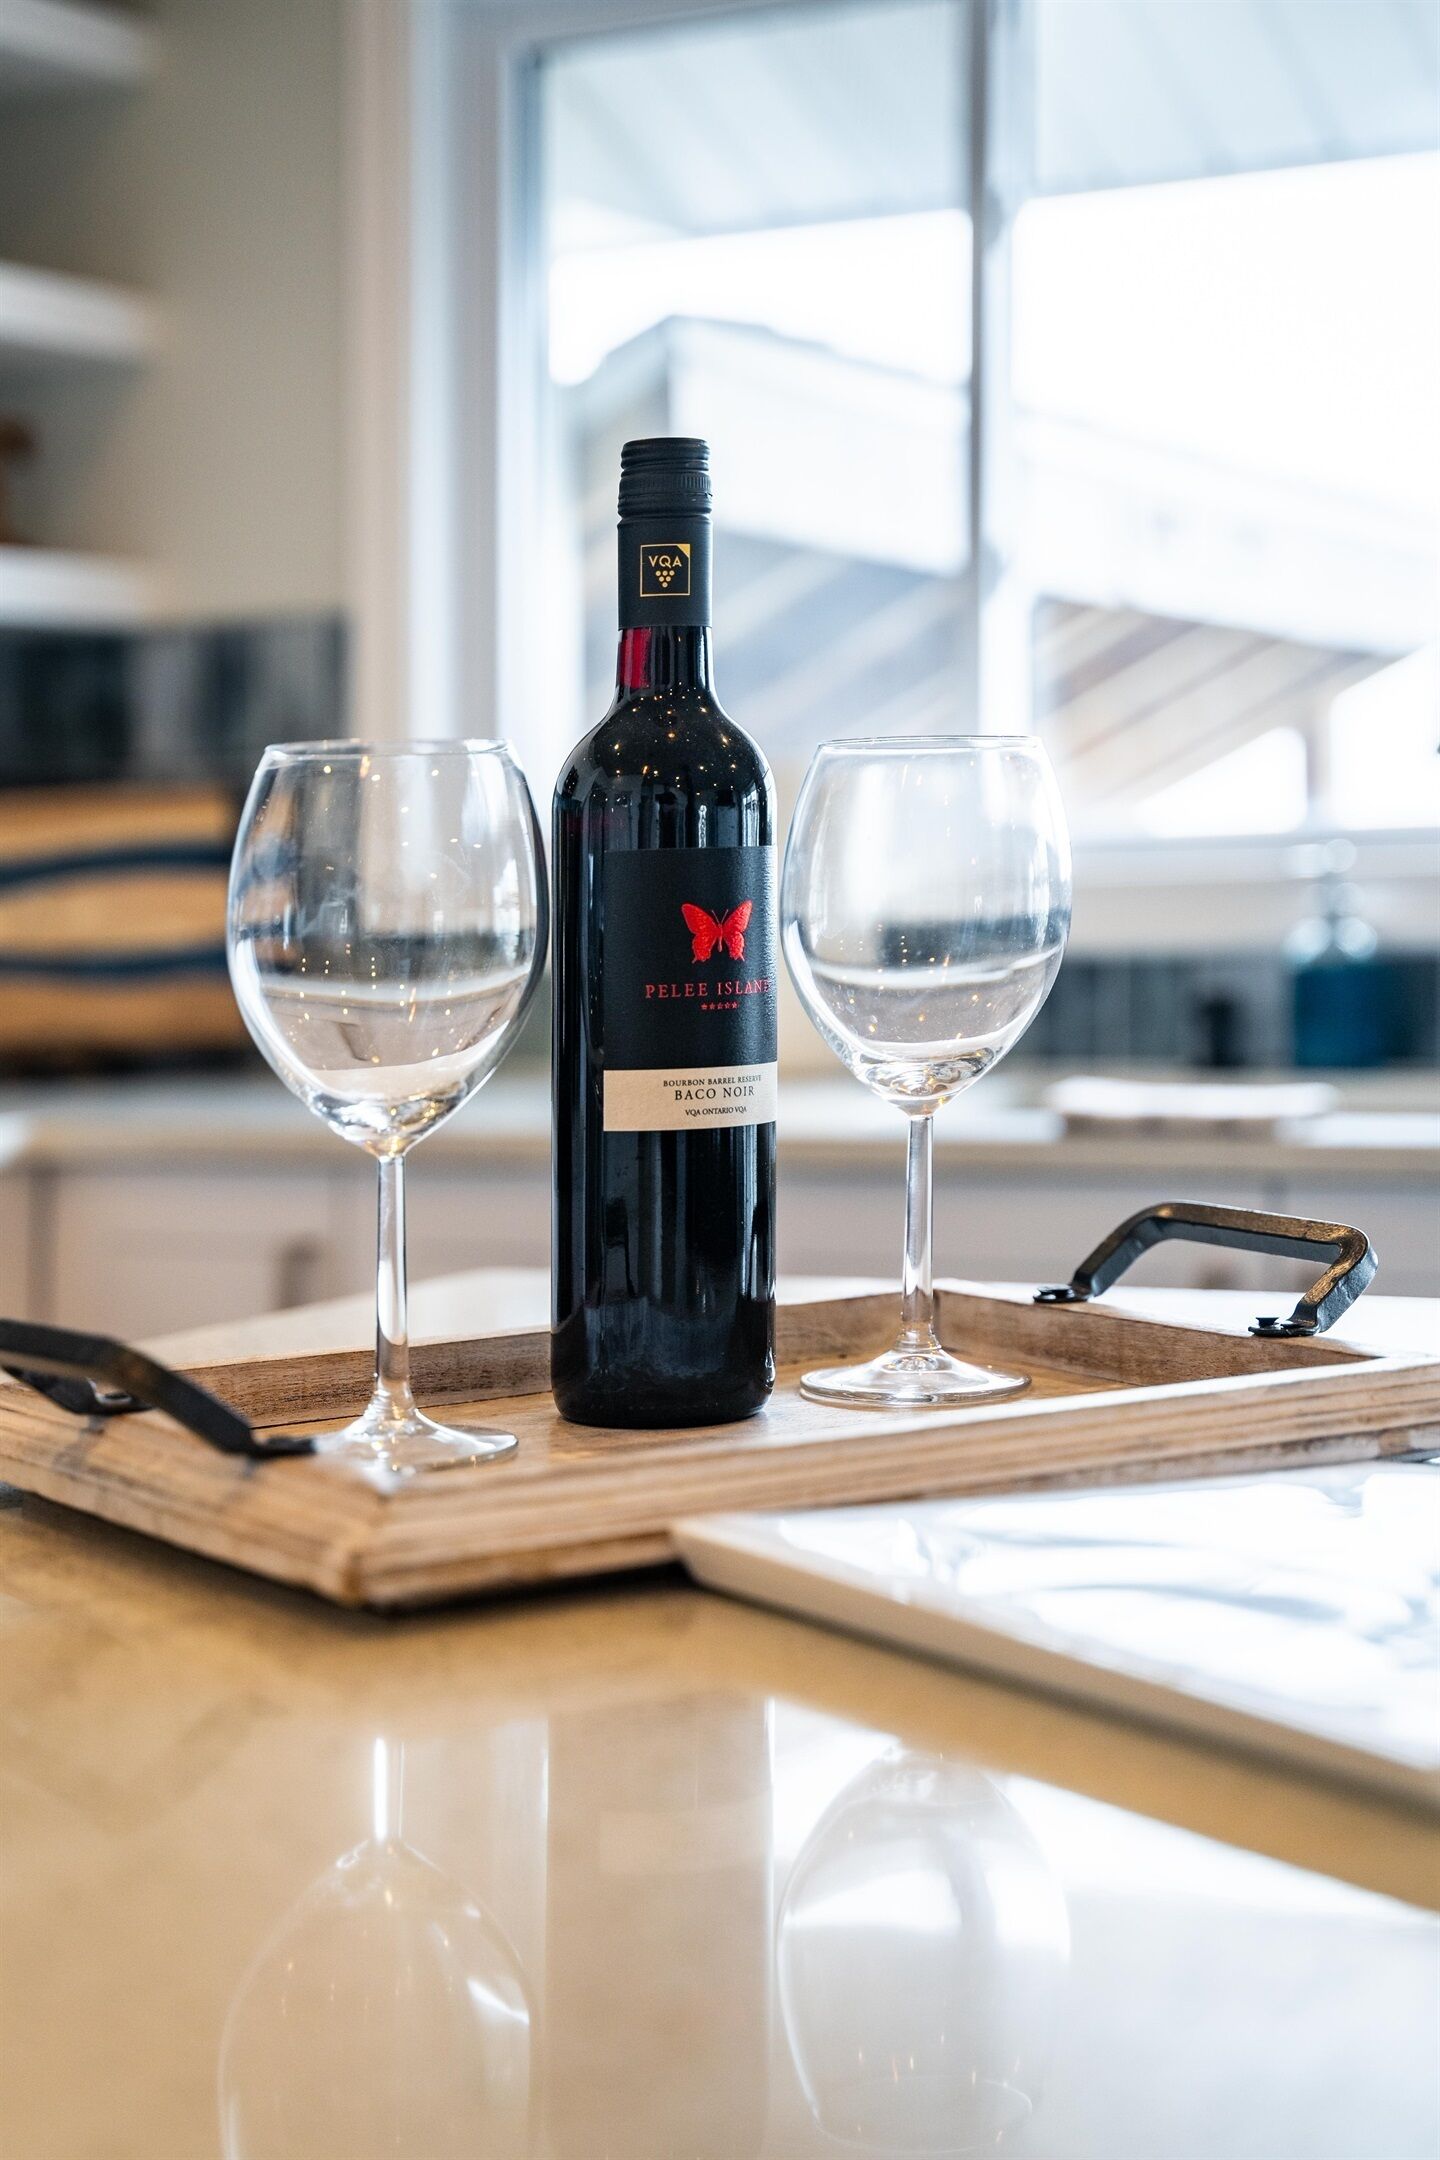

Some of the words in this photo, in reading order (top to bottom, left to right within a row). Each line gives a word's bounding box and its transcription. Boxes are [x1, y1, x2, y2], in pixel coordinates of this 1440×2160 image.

[649, 555, 682, 568] VQA
[645, 983, 708, 998] PELEE
[663, 1078, 705, 1087] BOURBON
[708, 1077, 736, 1085] BARREL
[738, 1074, 762, 1083] RESERVE
[675, 1088, 716, 1101] BACO
[723, 1085, 755, 1098] NOIR
[685, 1108, 701, 1117] VQA
[702, 1106, 734, 1115] ONTARIO
[735, 1105, 747, 1114] VQA
